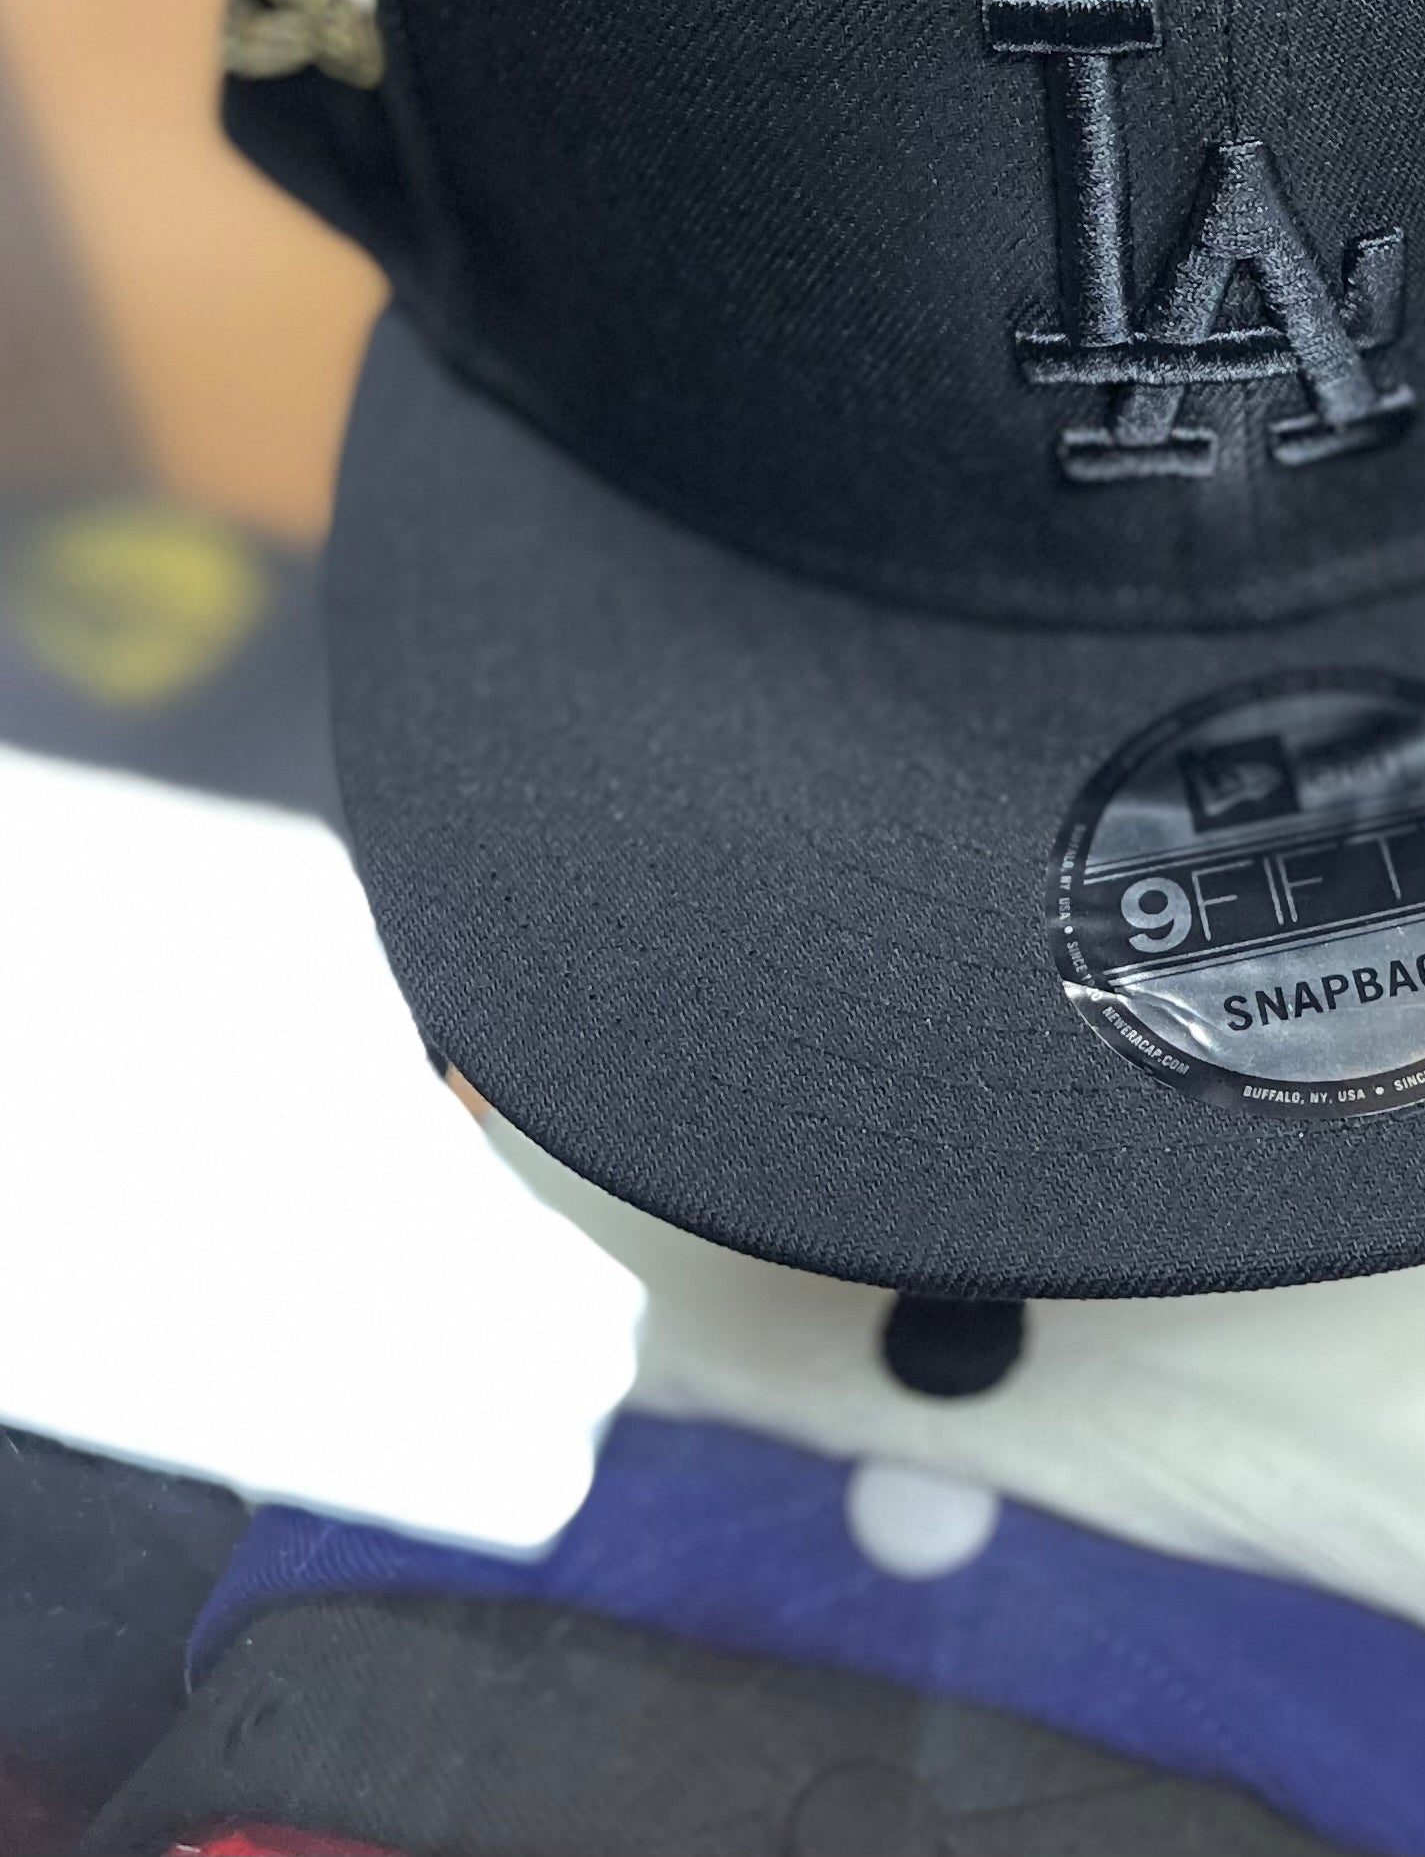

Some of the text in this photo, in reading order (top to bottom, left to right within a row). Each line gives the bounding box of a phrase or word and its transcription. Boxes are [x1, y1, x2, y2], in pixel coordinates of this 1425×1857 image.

[1058, 897, 1071, 921] USA
[1066, 941, 1089, 973] SINCE
[1101, 1005, 1190, 1075] NEWERACAP.COM
[1337, 1088, 1366, 1102] USA
